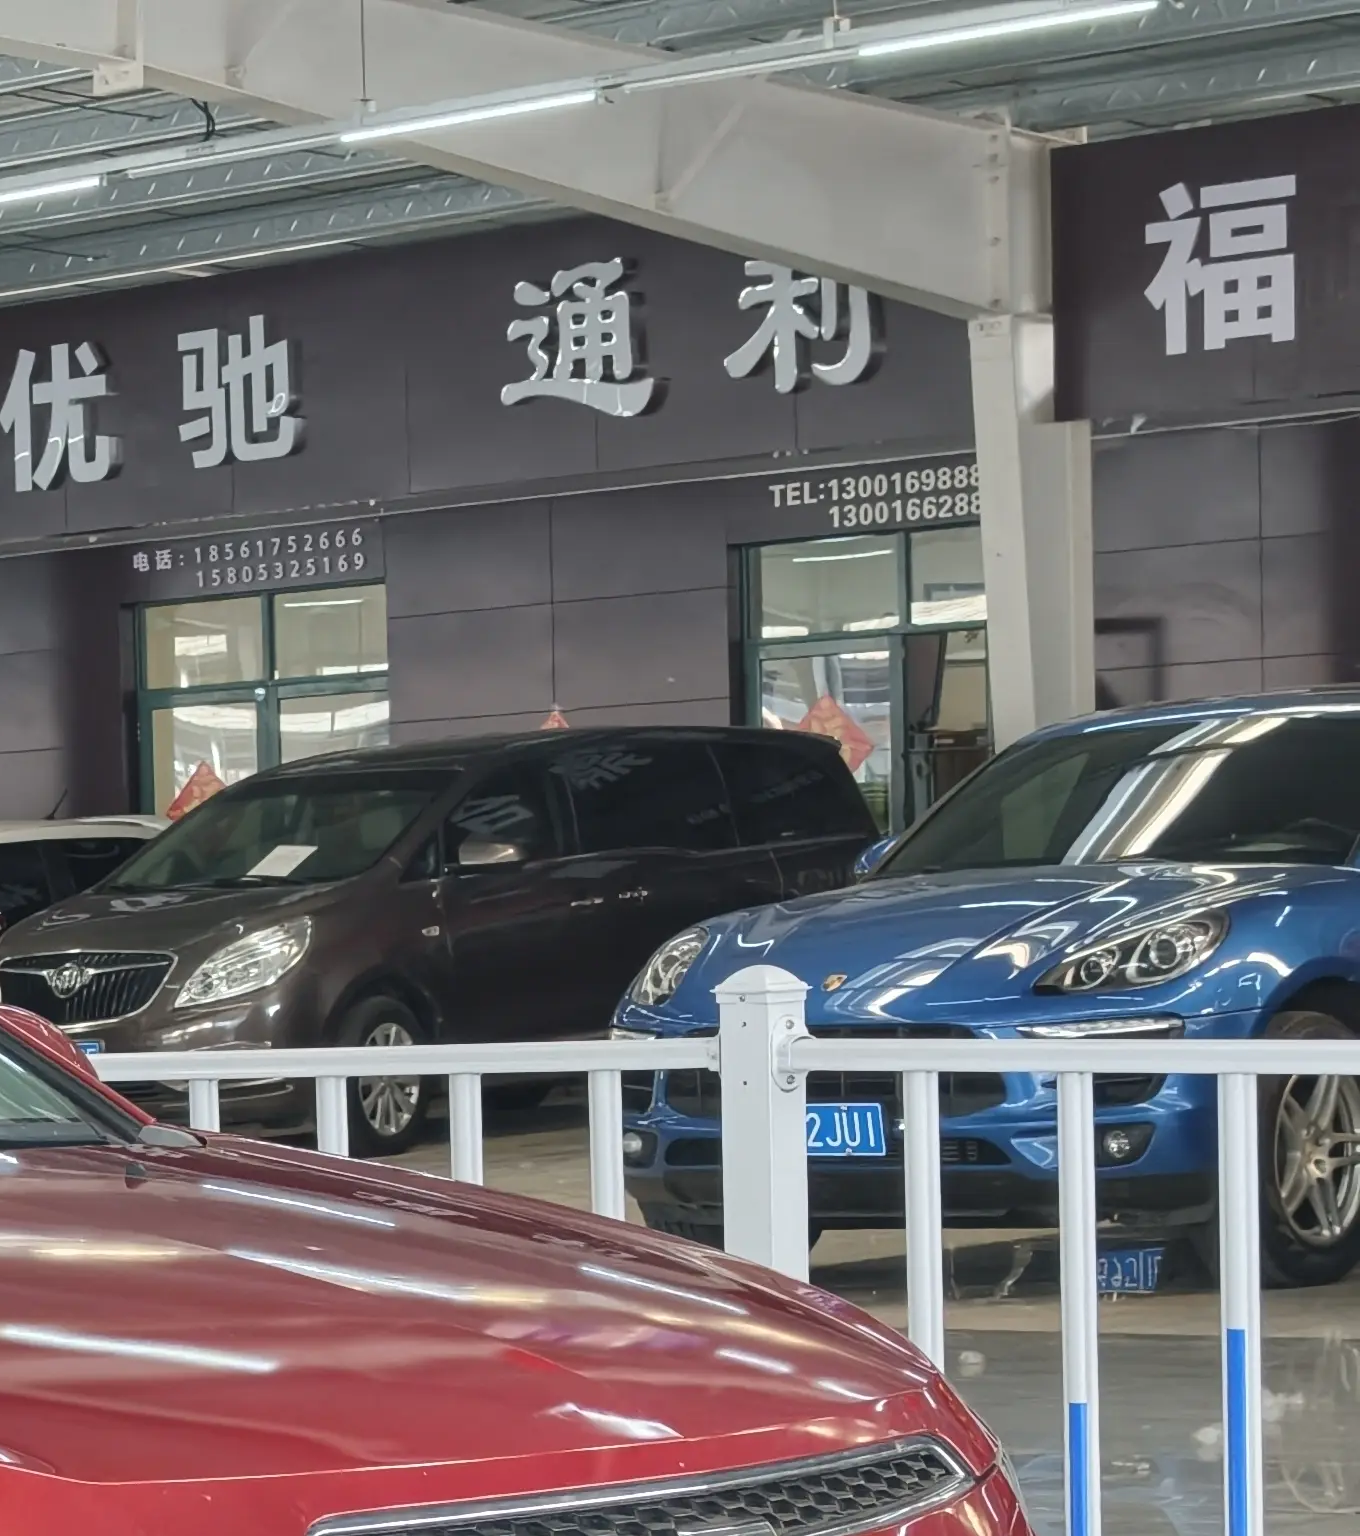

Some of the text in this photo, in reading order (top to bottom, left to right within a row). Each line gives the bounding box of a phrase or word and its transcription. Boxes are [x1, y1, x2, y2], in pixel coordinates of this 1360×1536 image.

[499, 254, 874, 417] 通利
[1142, 173, 1298, 357] 福
[195, 552, 365, 588] 15805325169
